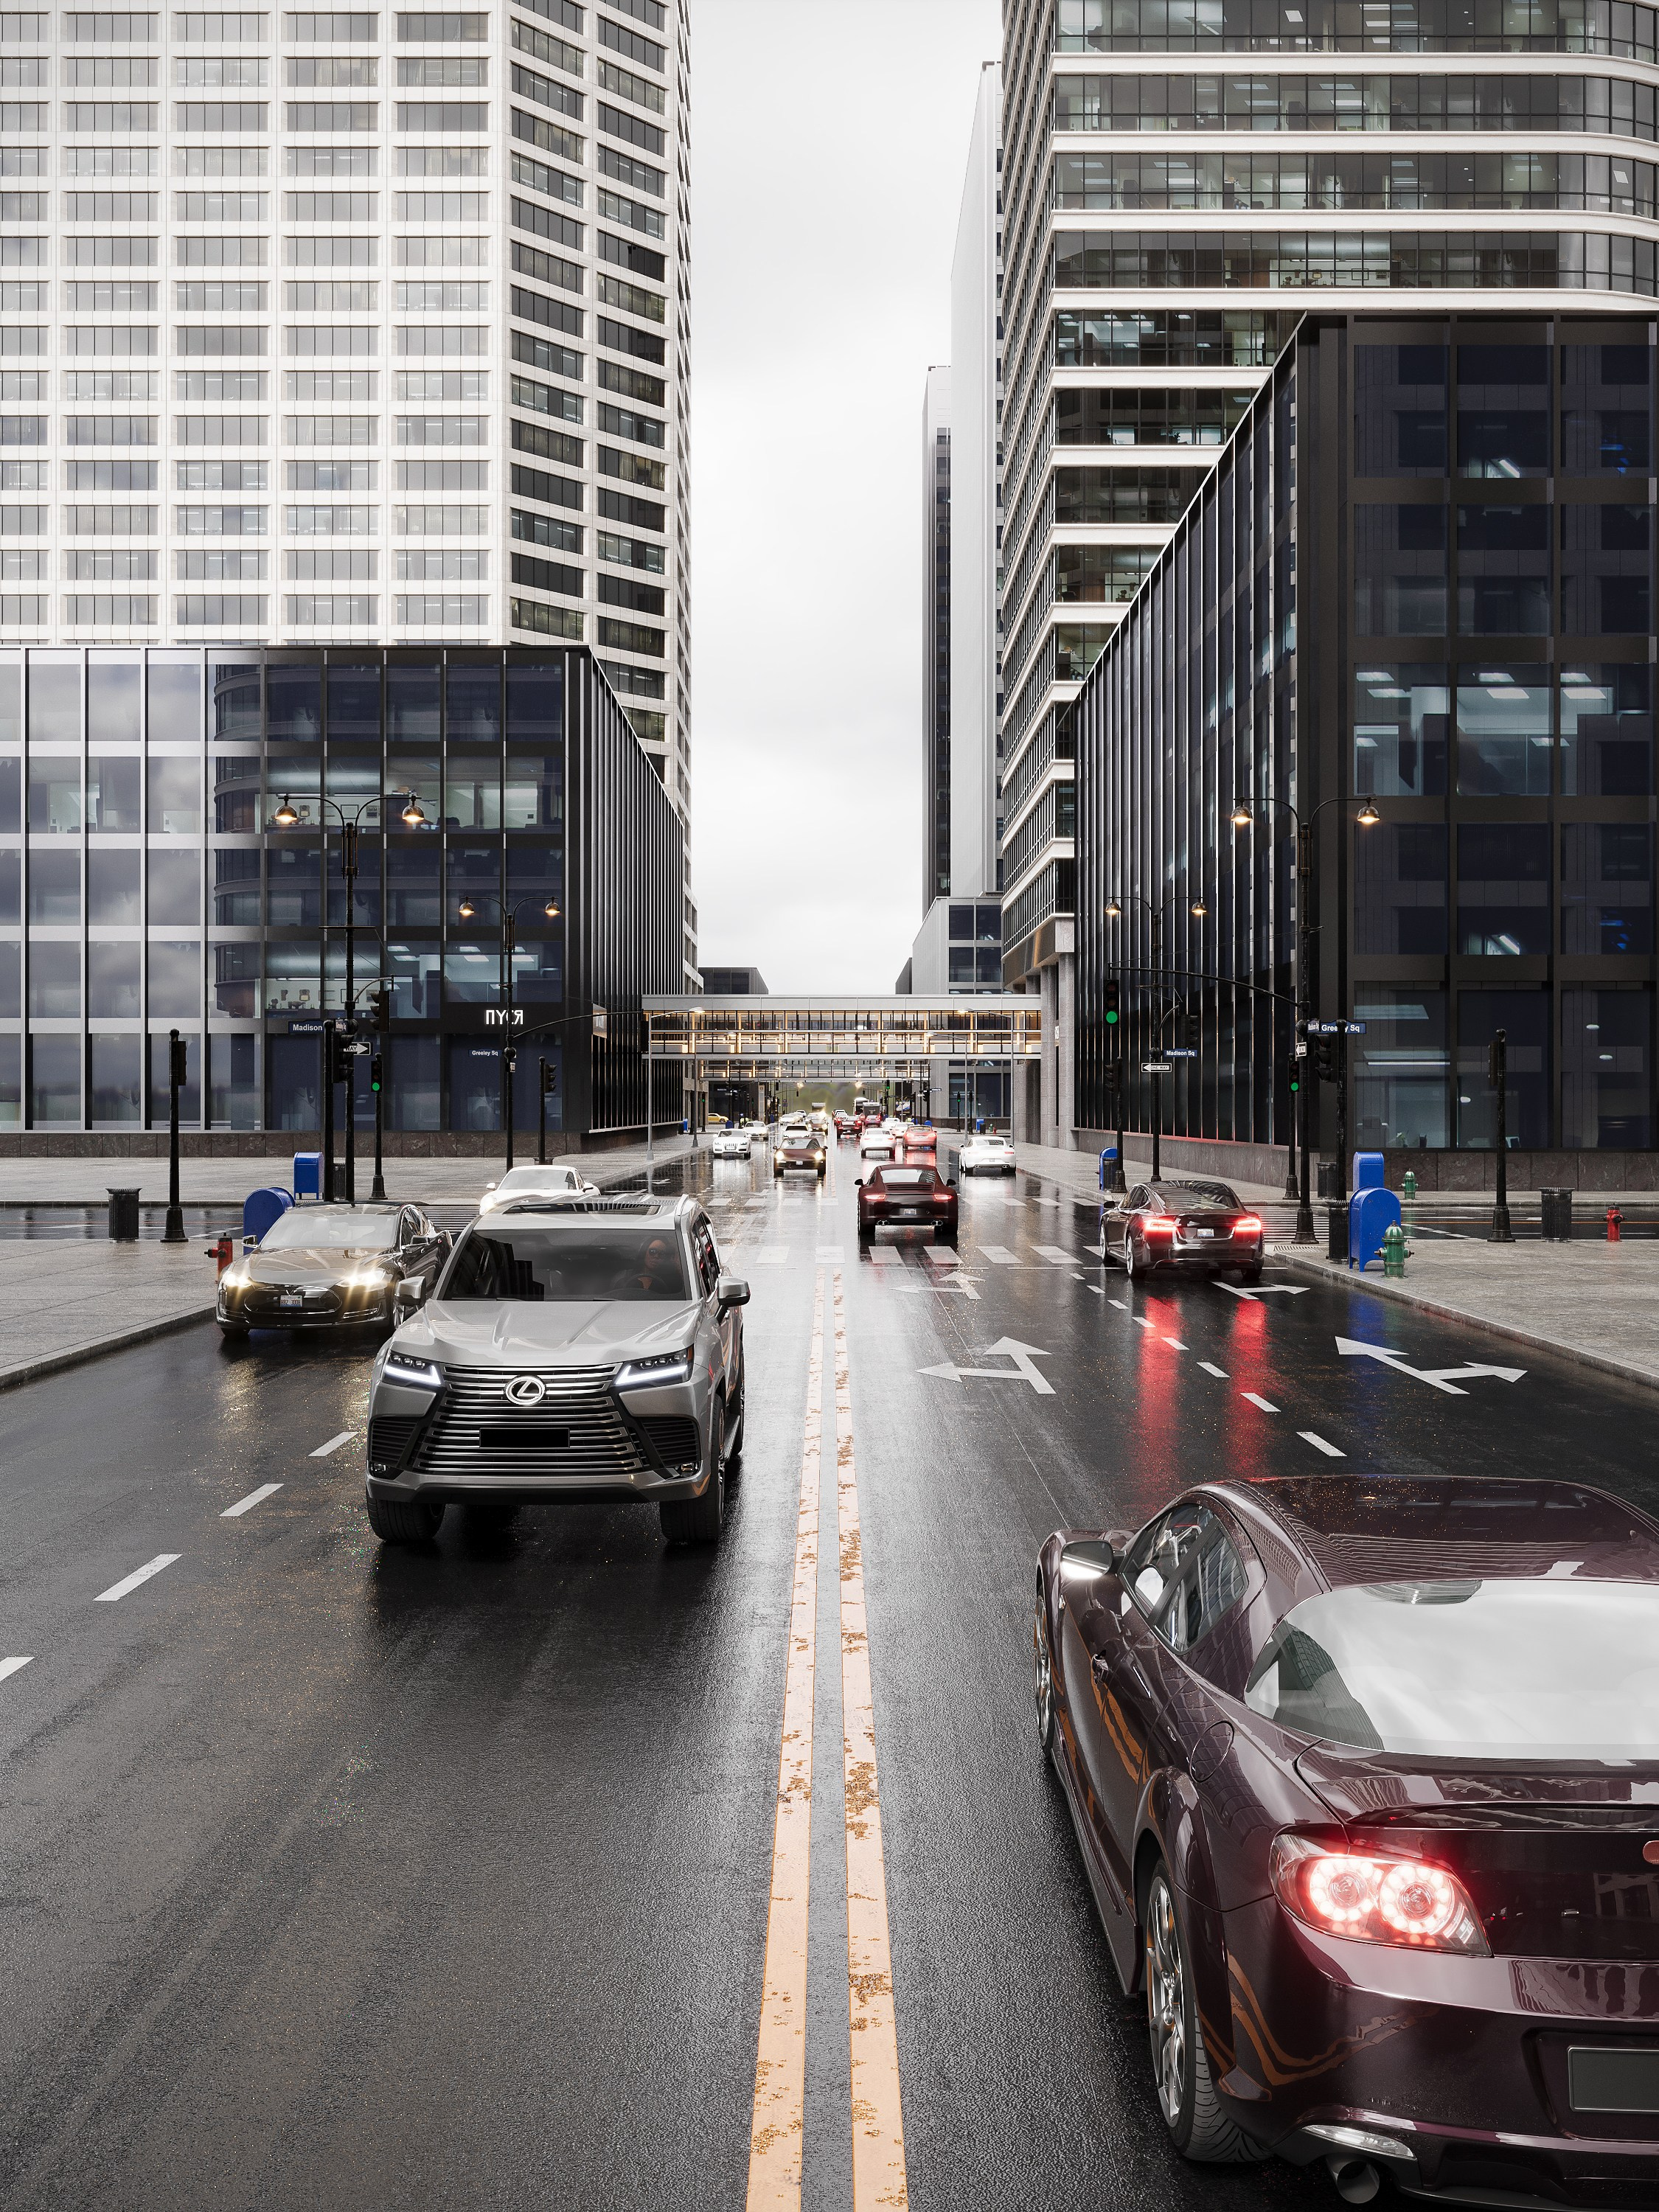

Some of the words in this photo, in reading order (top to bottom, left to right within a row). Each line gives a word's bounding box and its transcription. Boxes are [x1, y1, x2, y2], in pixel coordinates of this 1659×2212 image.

[293, 1023, 323, 1032] Madison
[1321, 1024, 1349, 1033] Greey
[1350, 1024, 1360, 1033] Sq
